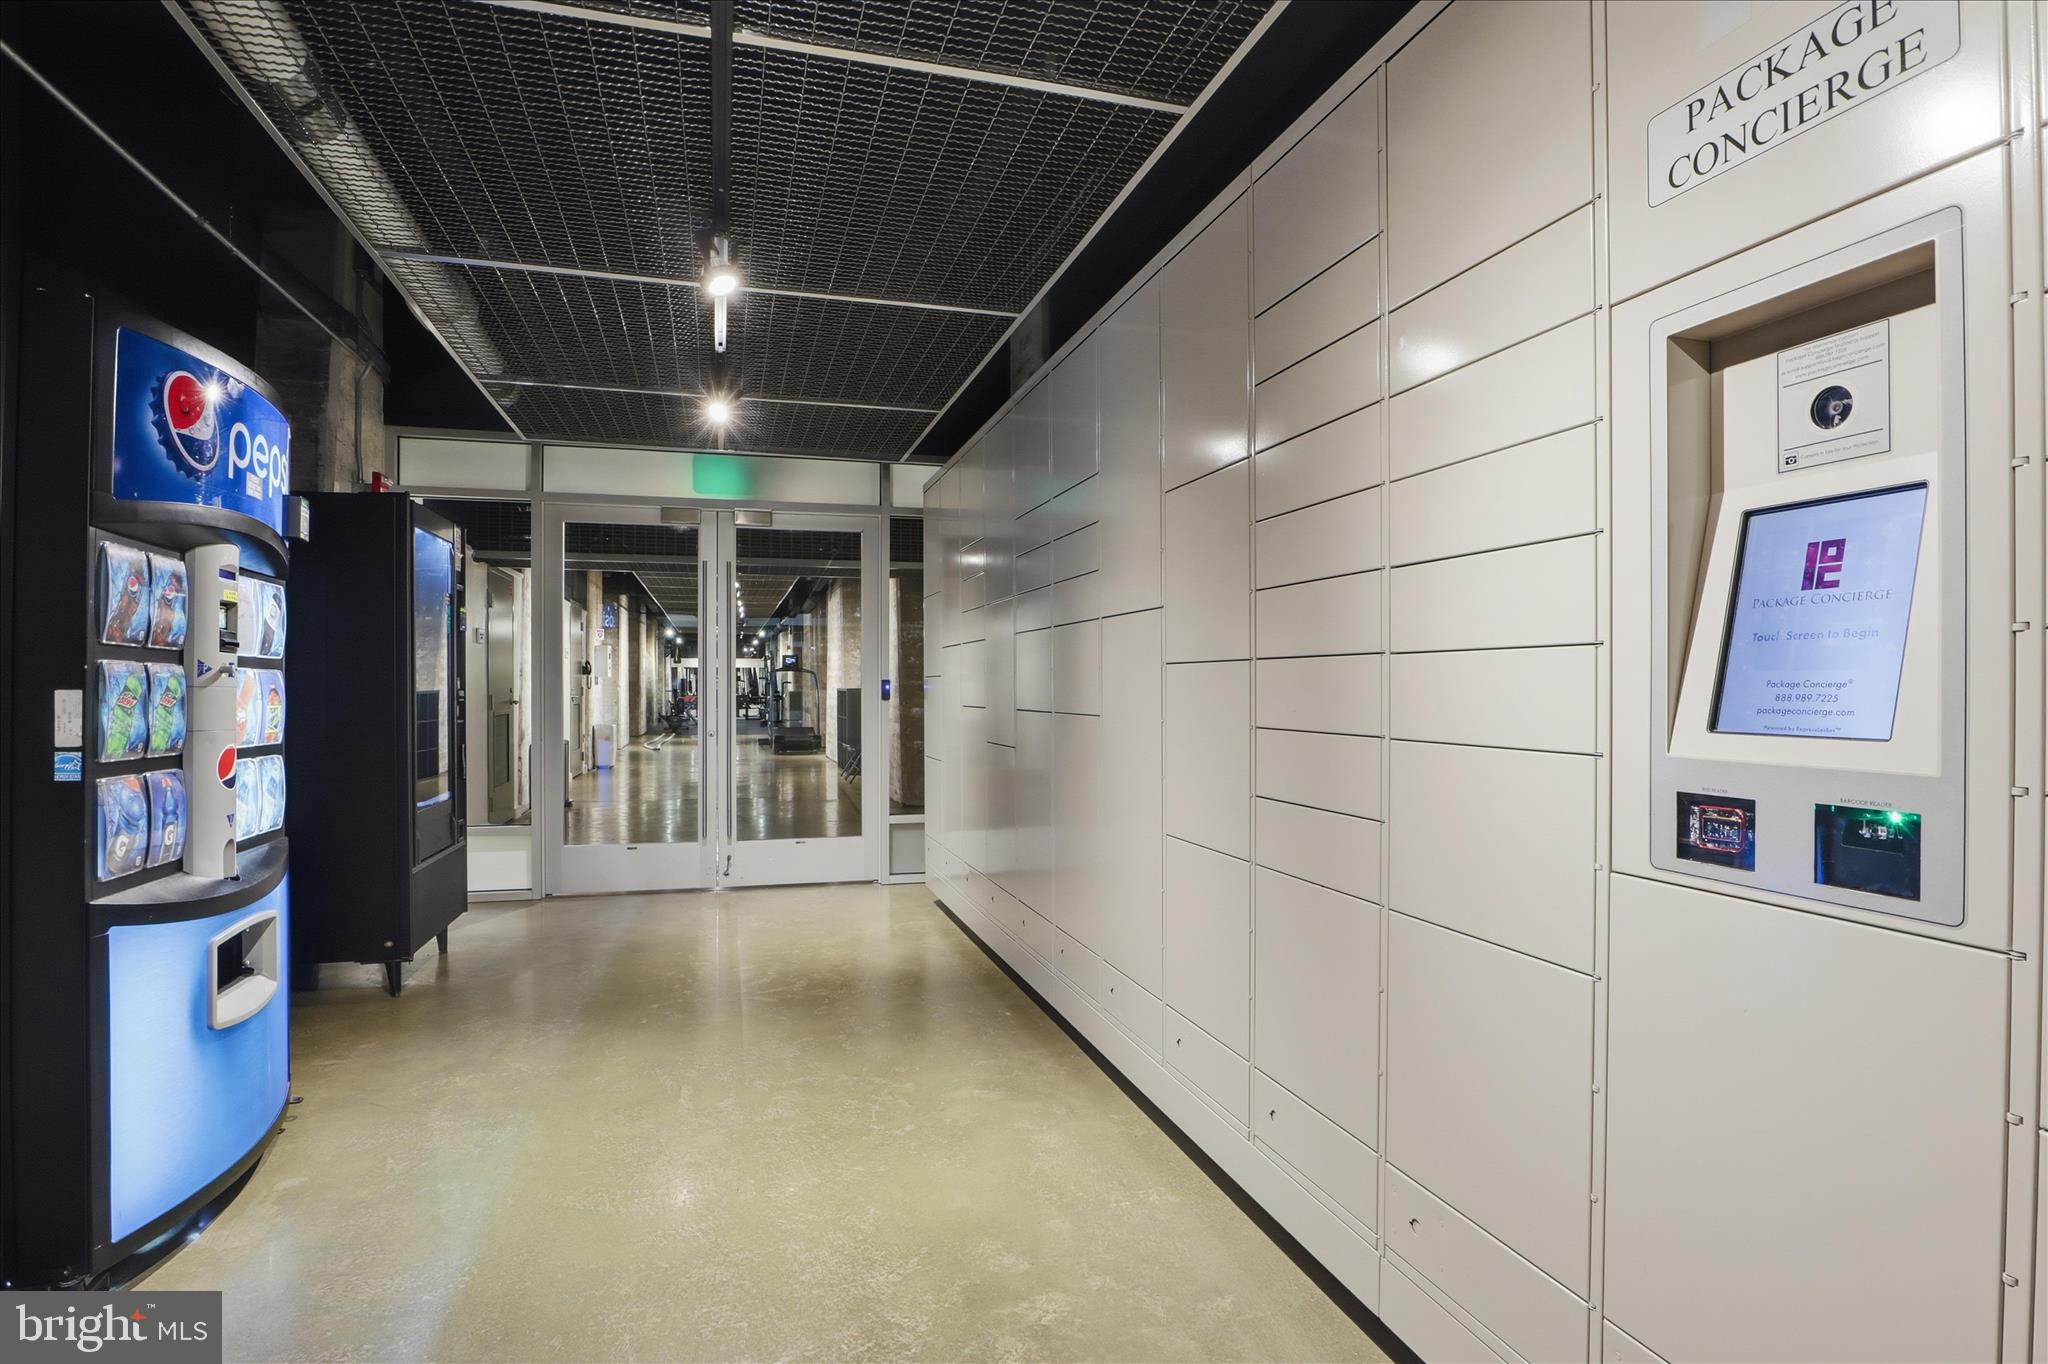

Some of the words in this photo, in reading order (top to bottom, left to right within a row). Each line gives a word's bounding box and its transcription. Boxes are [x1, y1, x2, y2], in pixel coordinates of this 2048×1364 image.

[1686, 0, 1898, 134] PACKAGE
[1668, 28, 1927, 188] CONCIERGE
[1752, 596, 1807, 608] PACKAGE
[1811, 589, 1894, 605] CONCIERGE
[1786, 630, 1824, 641] Screen
[1828, 628, 1840, 639] to
[1843, 626, 1879, 641] Begin
[1766, 679, 1801, 690] Package
[1775, 693, 1839, 703] 888.989.7225
[1757, 706, 1855, 718] packageconcierge.com
